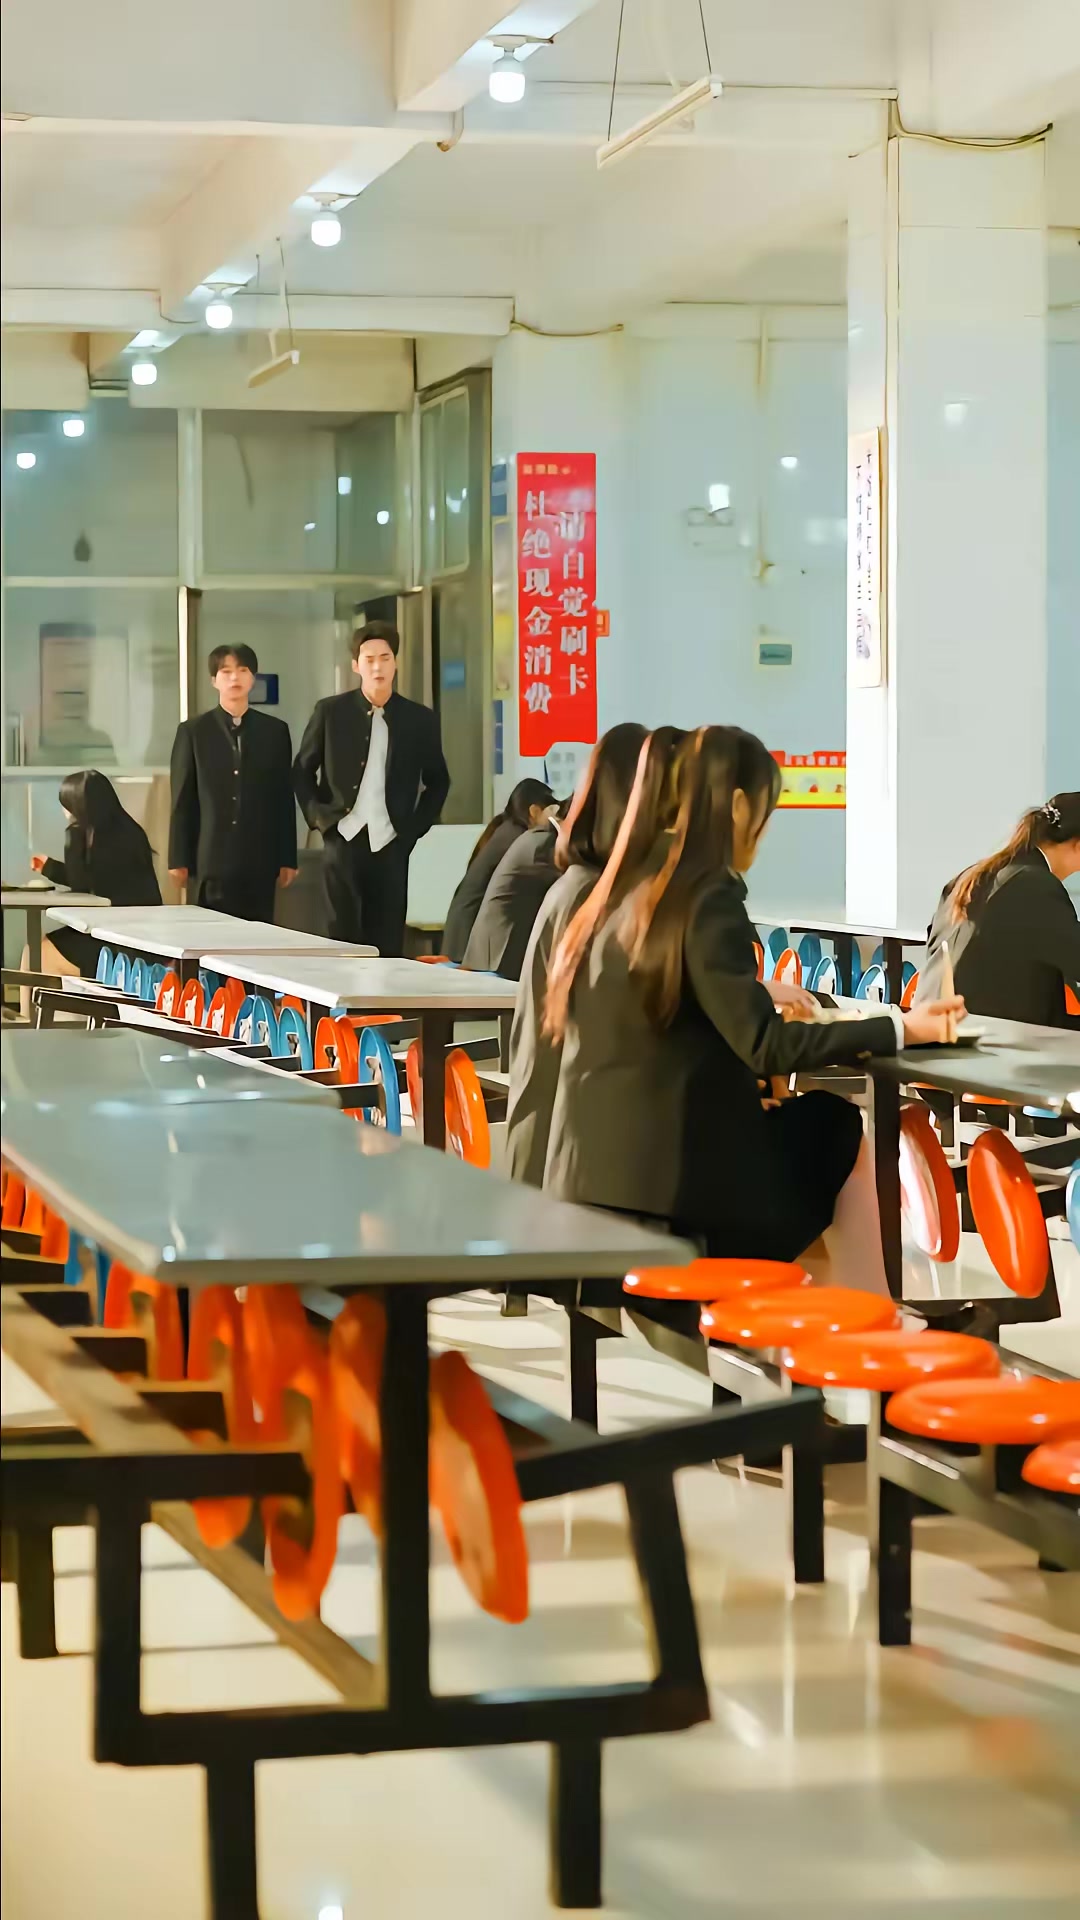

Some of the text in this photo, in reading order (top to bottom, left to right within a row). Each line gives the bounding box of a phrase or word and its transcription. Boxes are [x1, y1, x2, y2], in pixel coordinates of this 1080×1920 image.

[522, 490, 552, 714] 杜绝现金消费
